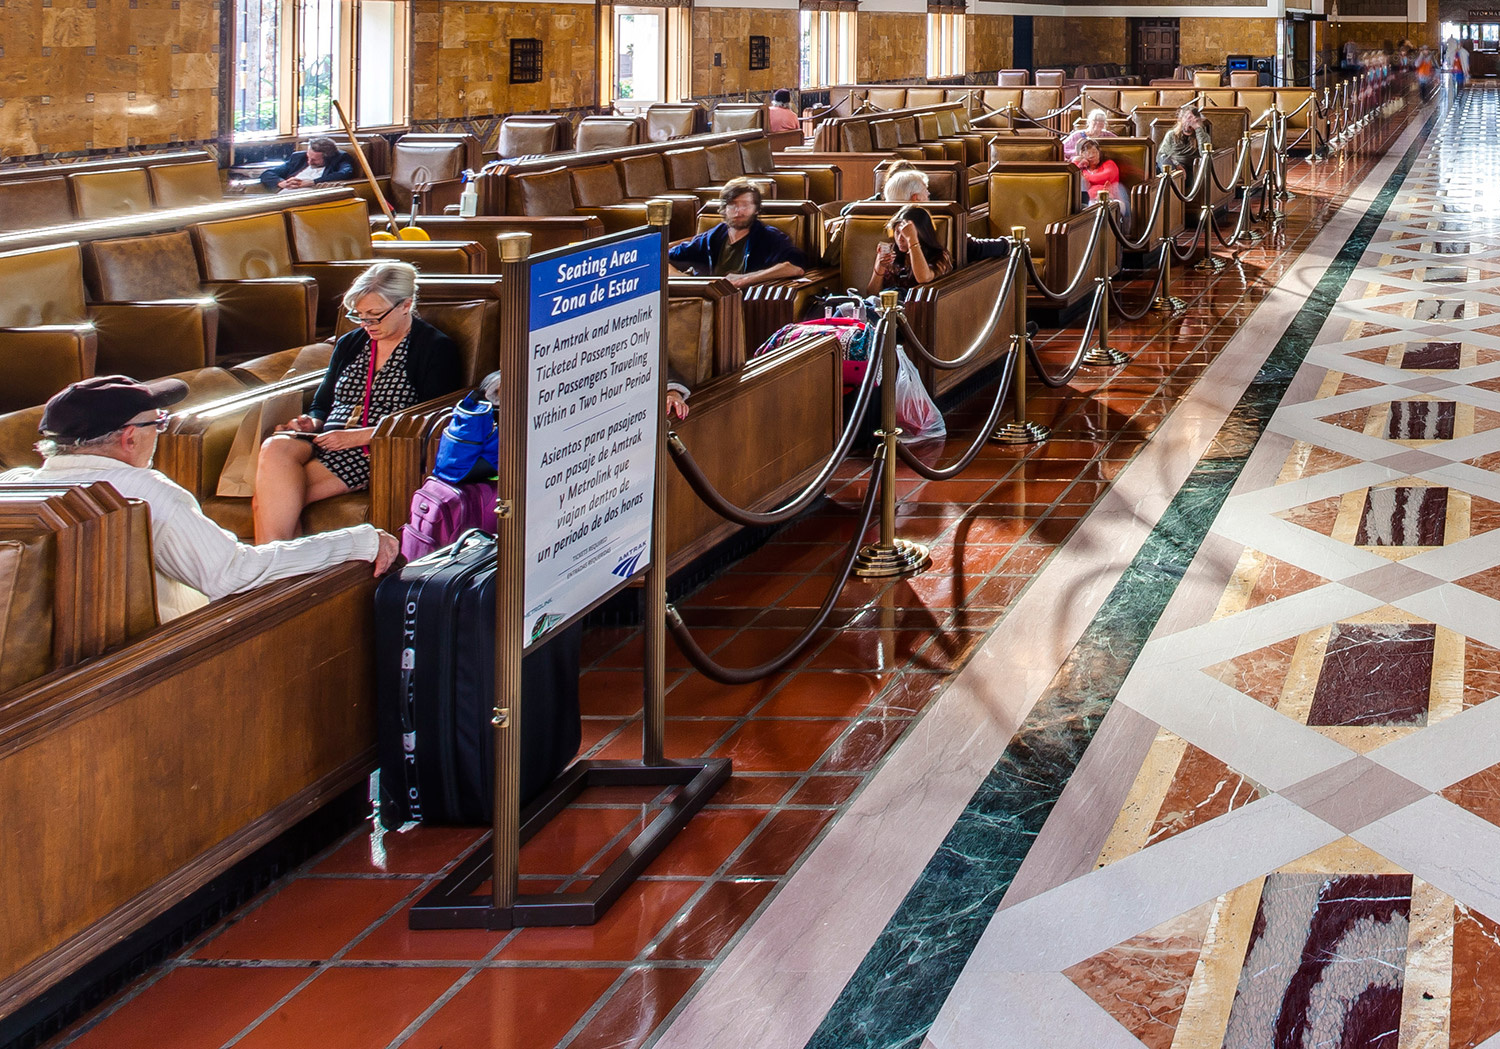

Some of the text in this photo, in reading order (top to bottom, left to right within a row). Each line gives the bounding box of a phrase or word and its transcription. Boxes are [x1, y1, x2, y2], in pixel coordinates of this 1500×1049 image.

[557, 250, 638, 283] Seating Area
[551, 277, 639, 316] Zona de Estar
[534, 305, 653, 360] For Amtrak and Metrolink
[536, 328, 650, 382] Ticketed Passengers Only
[533, 367, 652, 430] Within a Two Hour Period
[538, 352, 648, 405] For Passengers Traveling
[540, 409, 647, 468] Asientos para pasajeros
[545, 428, 643, 489] con pasaje de Amtrak
[557, 478, 630, 529] viajan dentro de
[559, 459, 630, 509] y Metrolink que
[537, 492, 643, 563] un periodo de dos horas
[618, 541, 647, 562] AMTRAK
